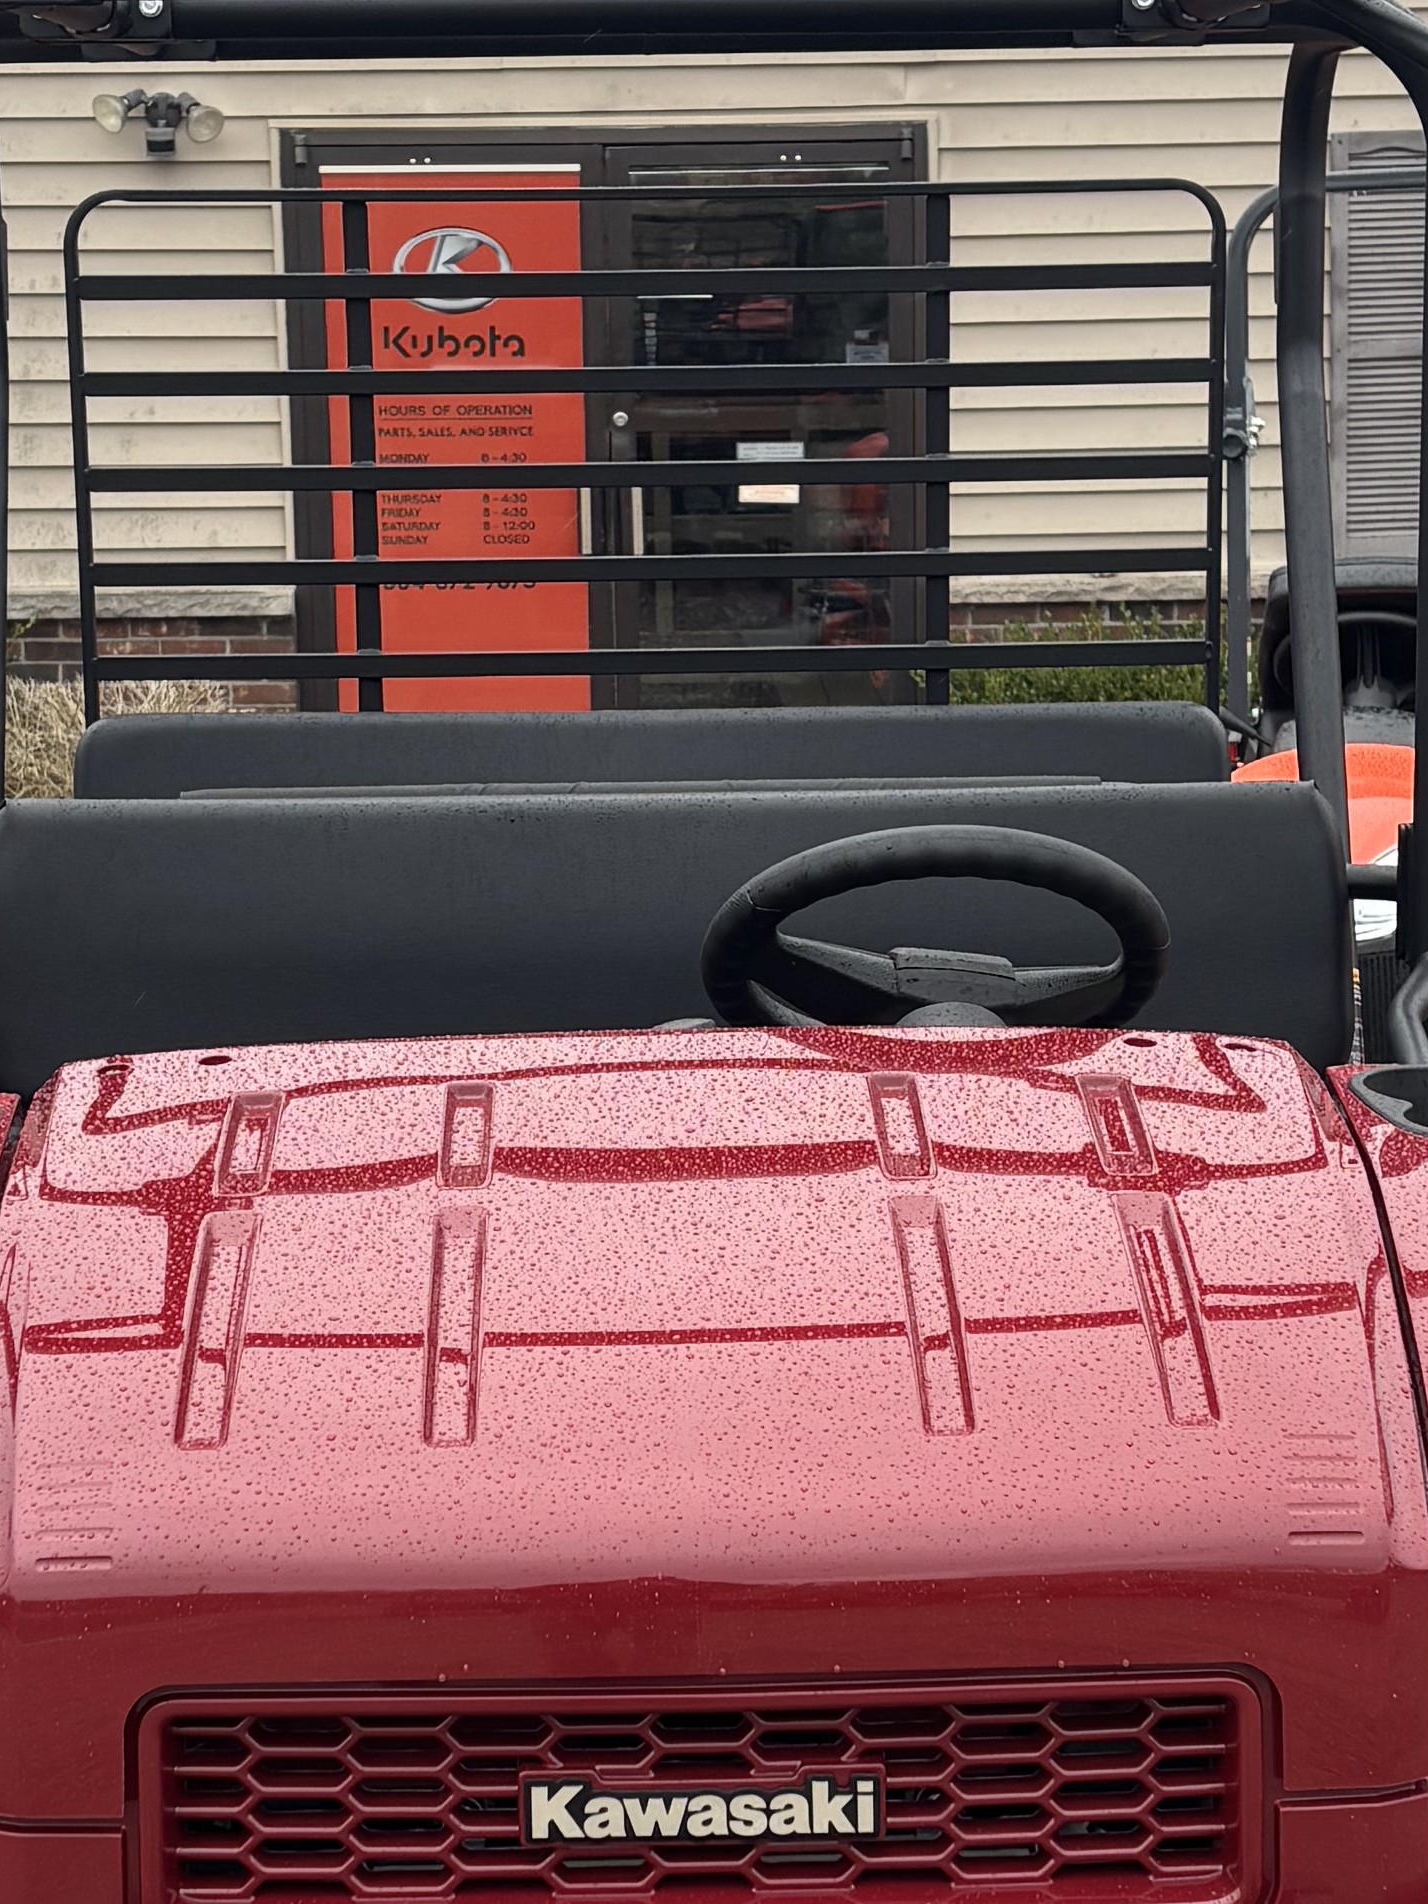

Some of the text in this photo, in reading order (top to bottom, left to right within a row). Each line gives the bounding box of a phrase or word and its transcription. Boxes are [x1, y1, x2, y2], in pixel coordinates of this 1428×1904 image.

[383, 325, 526, 358] Kubota
[378, 404, 533, 417] HOURS OF OPERATION
[378, 427, 414, 438] PARTS,
[460, 427, 485, 437] AND
[379, 453, 429, 463] MONDAY
[381, 493, 442, 504] THURSDAY
[483, 493, 490, 503] 8
[502, 493, 527, 503] 4:30
[381, 507, 421, 517] FRIDAY
[483, 507, 490, 517] 8
[502, 507, 528, 517] 4:30
[381, 521, 440, 531] SATURDAY
[483, 521, 490, 530] 8
[503, 521, 535, 531] 12:00
[381, 534, 530, 545] SUNDAY CLOSED
[530, 1780, 874, 1840] Kawasaki
